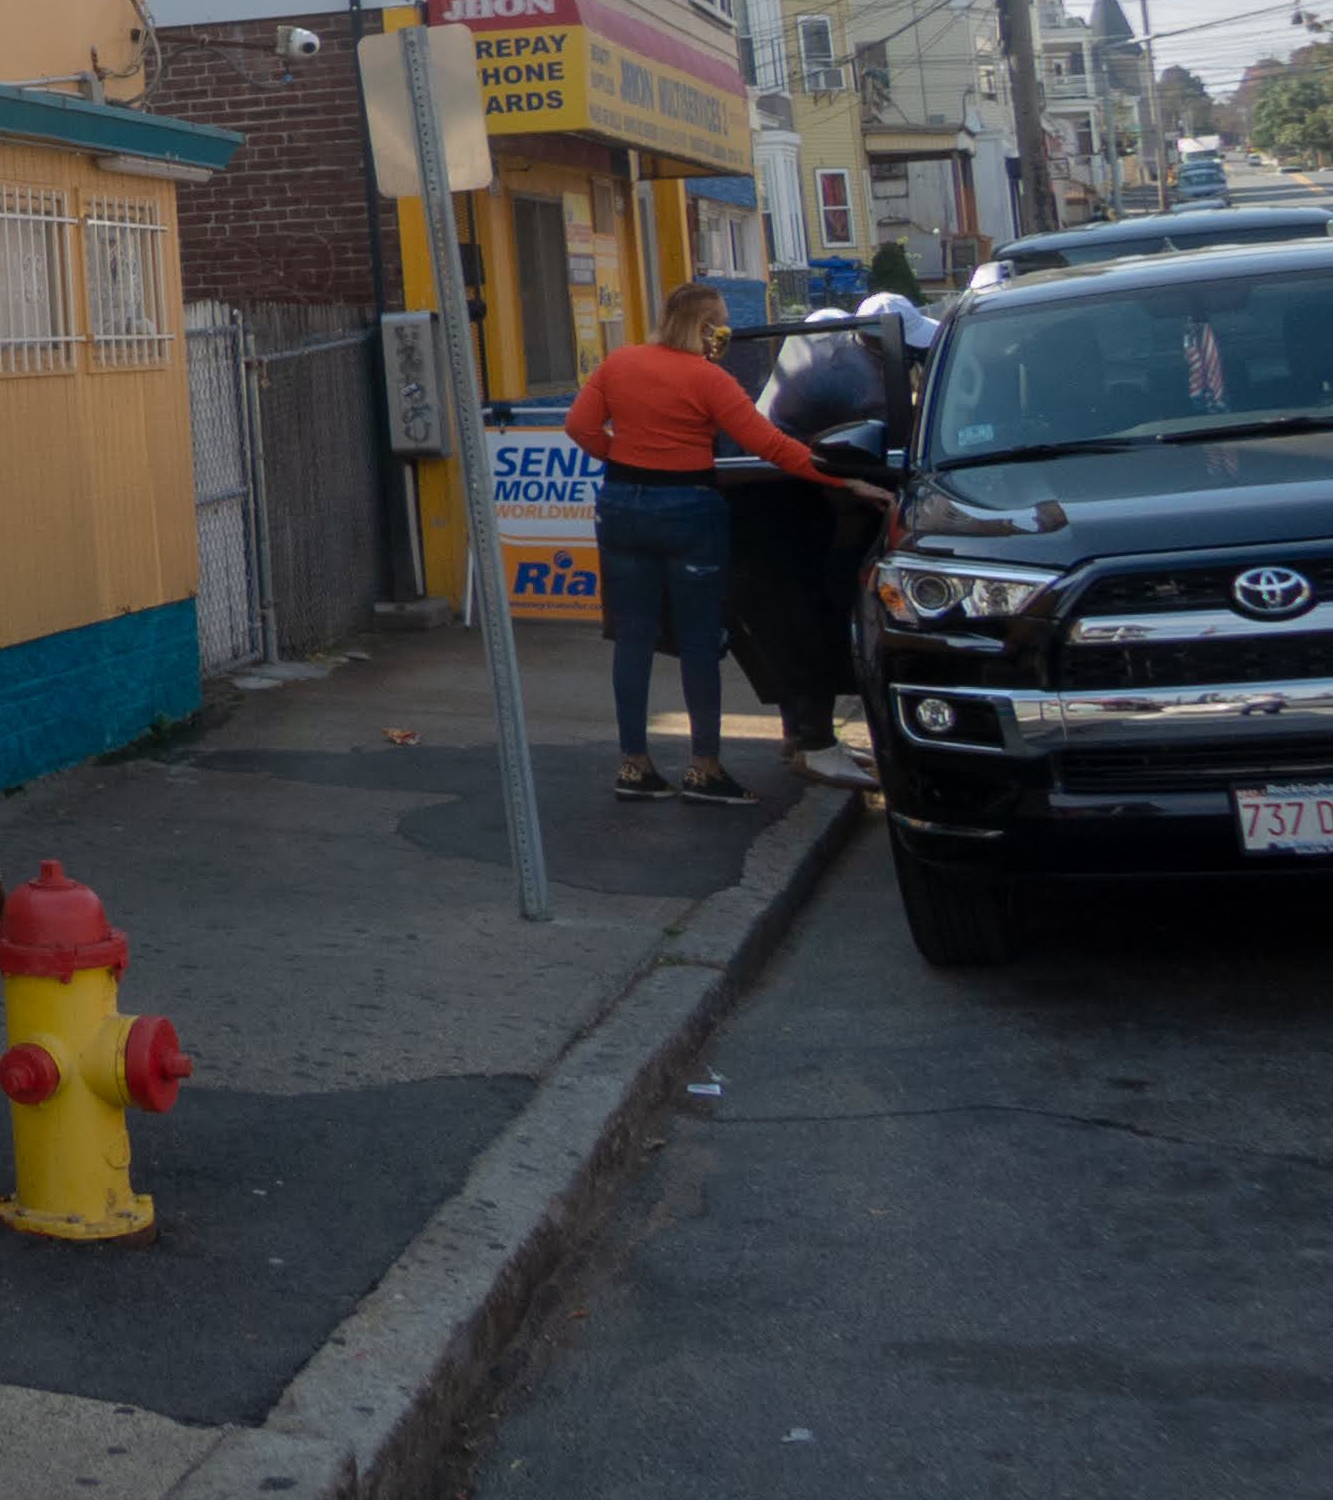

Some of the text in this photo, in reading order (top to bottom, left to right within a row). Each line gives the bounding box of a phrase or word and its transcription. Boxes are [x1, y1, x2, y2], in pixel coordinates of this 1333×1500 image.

[475, 34, 568, 60] REPAY
[478, 61, 565, 87] HONE
[484, 89, 564, 116] ARDS
[514, 550, 598, 596] Ria
[1243, 802, 1304, 837] 737
